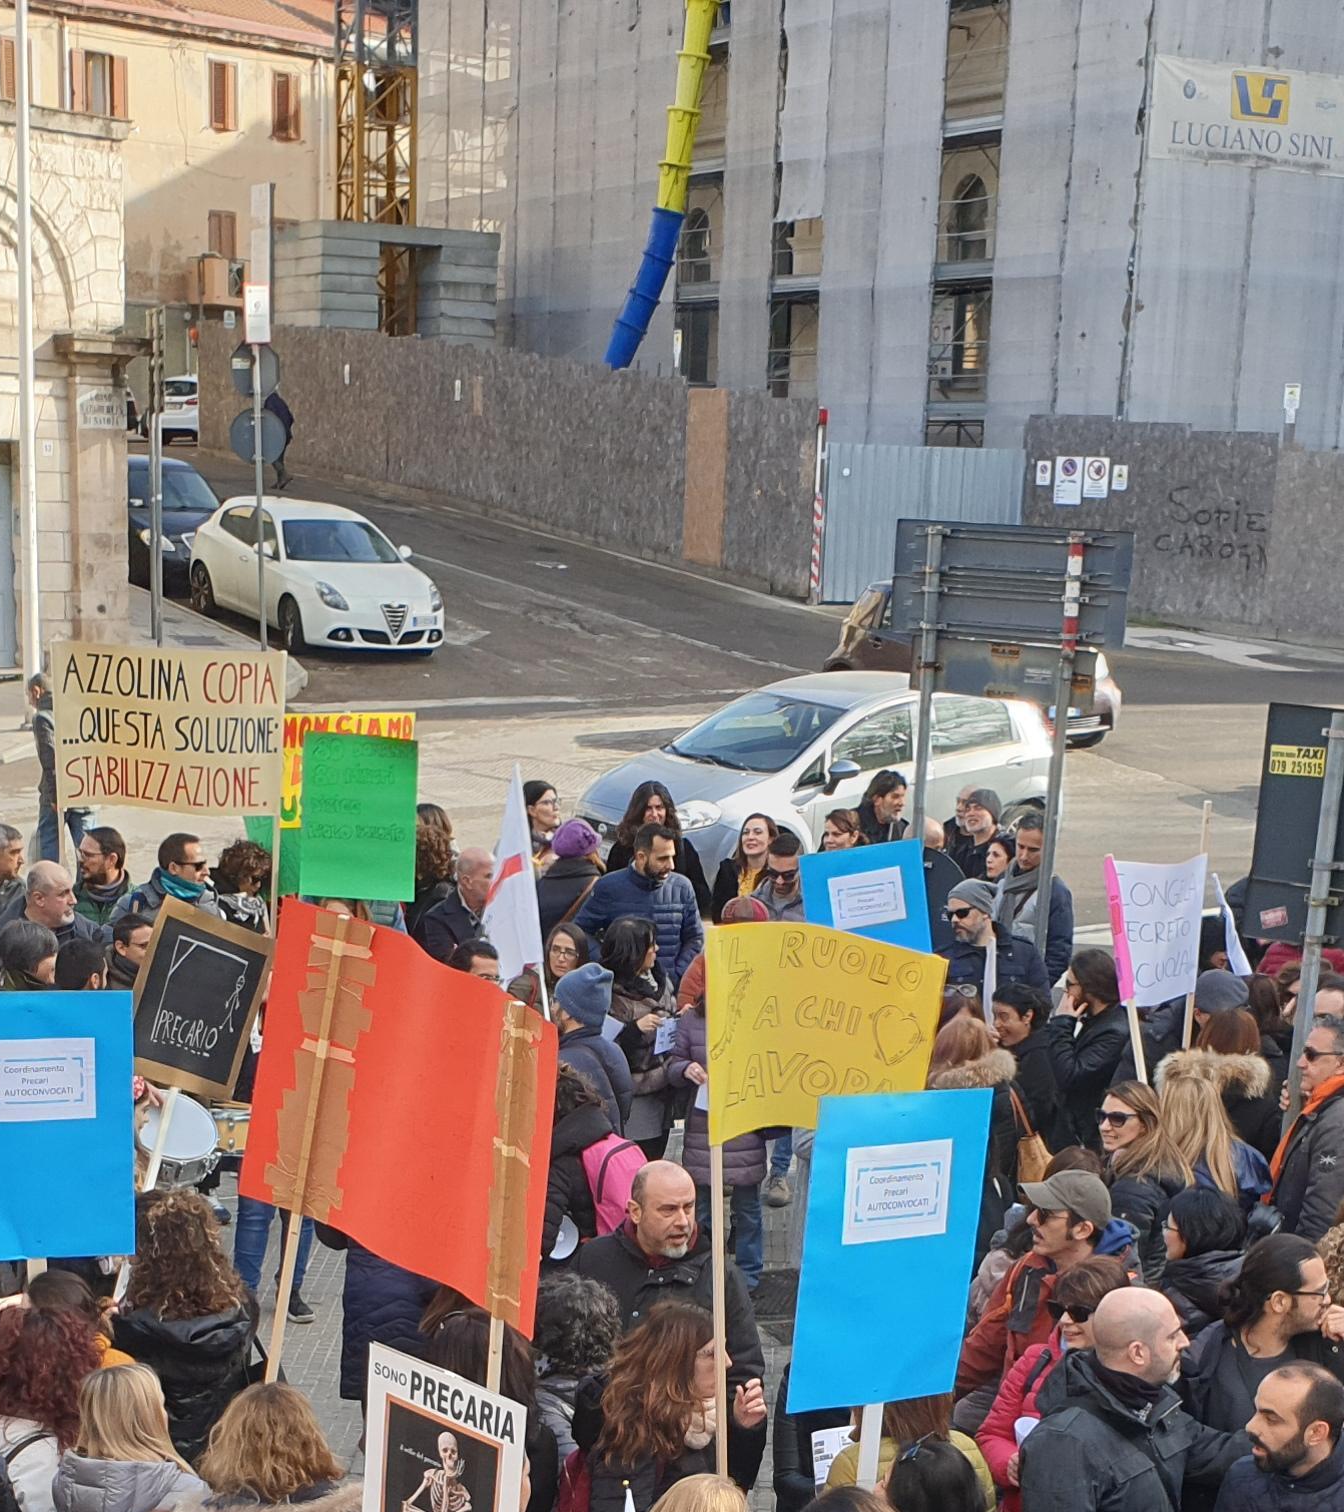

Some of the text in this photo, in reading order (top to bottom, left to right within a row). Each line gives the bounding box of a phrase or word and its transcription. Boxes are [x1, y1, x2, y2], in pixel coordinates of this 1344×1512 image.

[1171, 121, 1282, 154] LUCIANO
[1288, 133, 1333, 160] SINI
[62, 652, 278, 705] AZZOLINA COPIA
[62, 706, 279, 754] ...QUESTA SOLUZIONE:
[1270, 759, 1323, 776] 079 251515
[1296, 747, 1325, 760] TAXI
[65, 755, 268, 808] STABILIZZAZIONE.
[1126, 916, 1192, 945] ECRETO
[778, 930, 924, 993] RUOLO
[154, 1009, 219, 1051] PRECARIO
[752, 995, 863, 1036] A CHI
[3, 1065, 65, 1074] Coordinamento
[21, 1077, 49, 1085] Precari
[4, 1086, 74, 1097] AUTOCONVOCATI
[869, 1173, 924, 1185] Coordinamento
[883, 1186, 908, 1197] Precari
[867, 1198, 929, 1212] AUTOCONVOCATI
[373, 1361, 516, 1445] SONO PRECARIA
